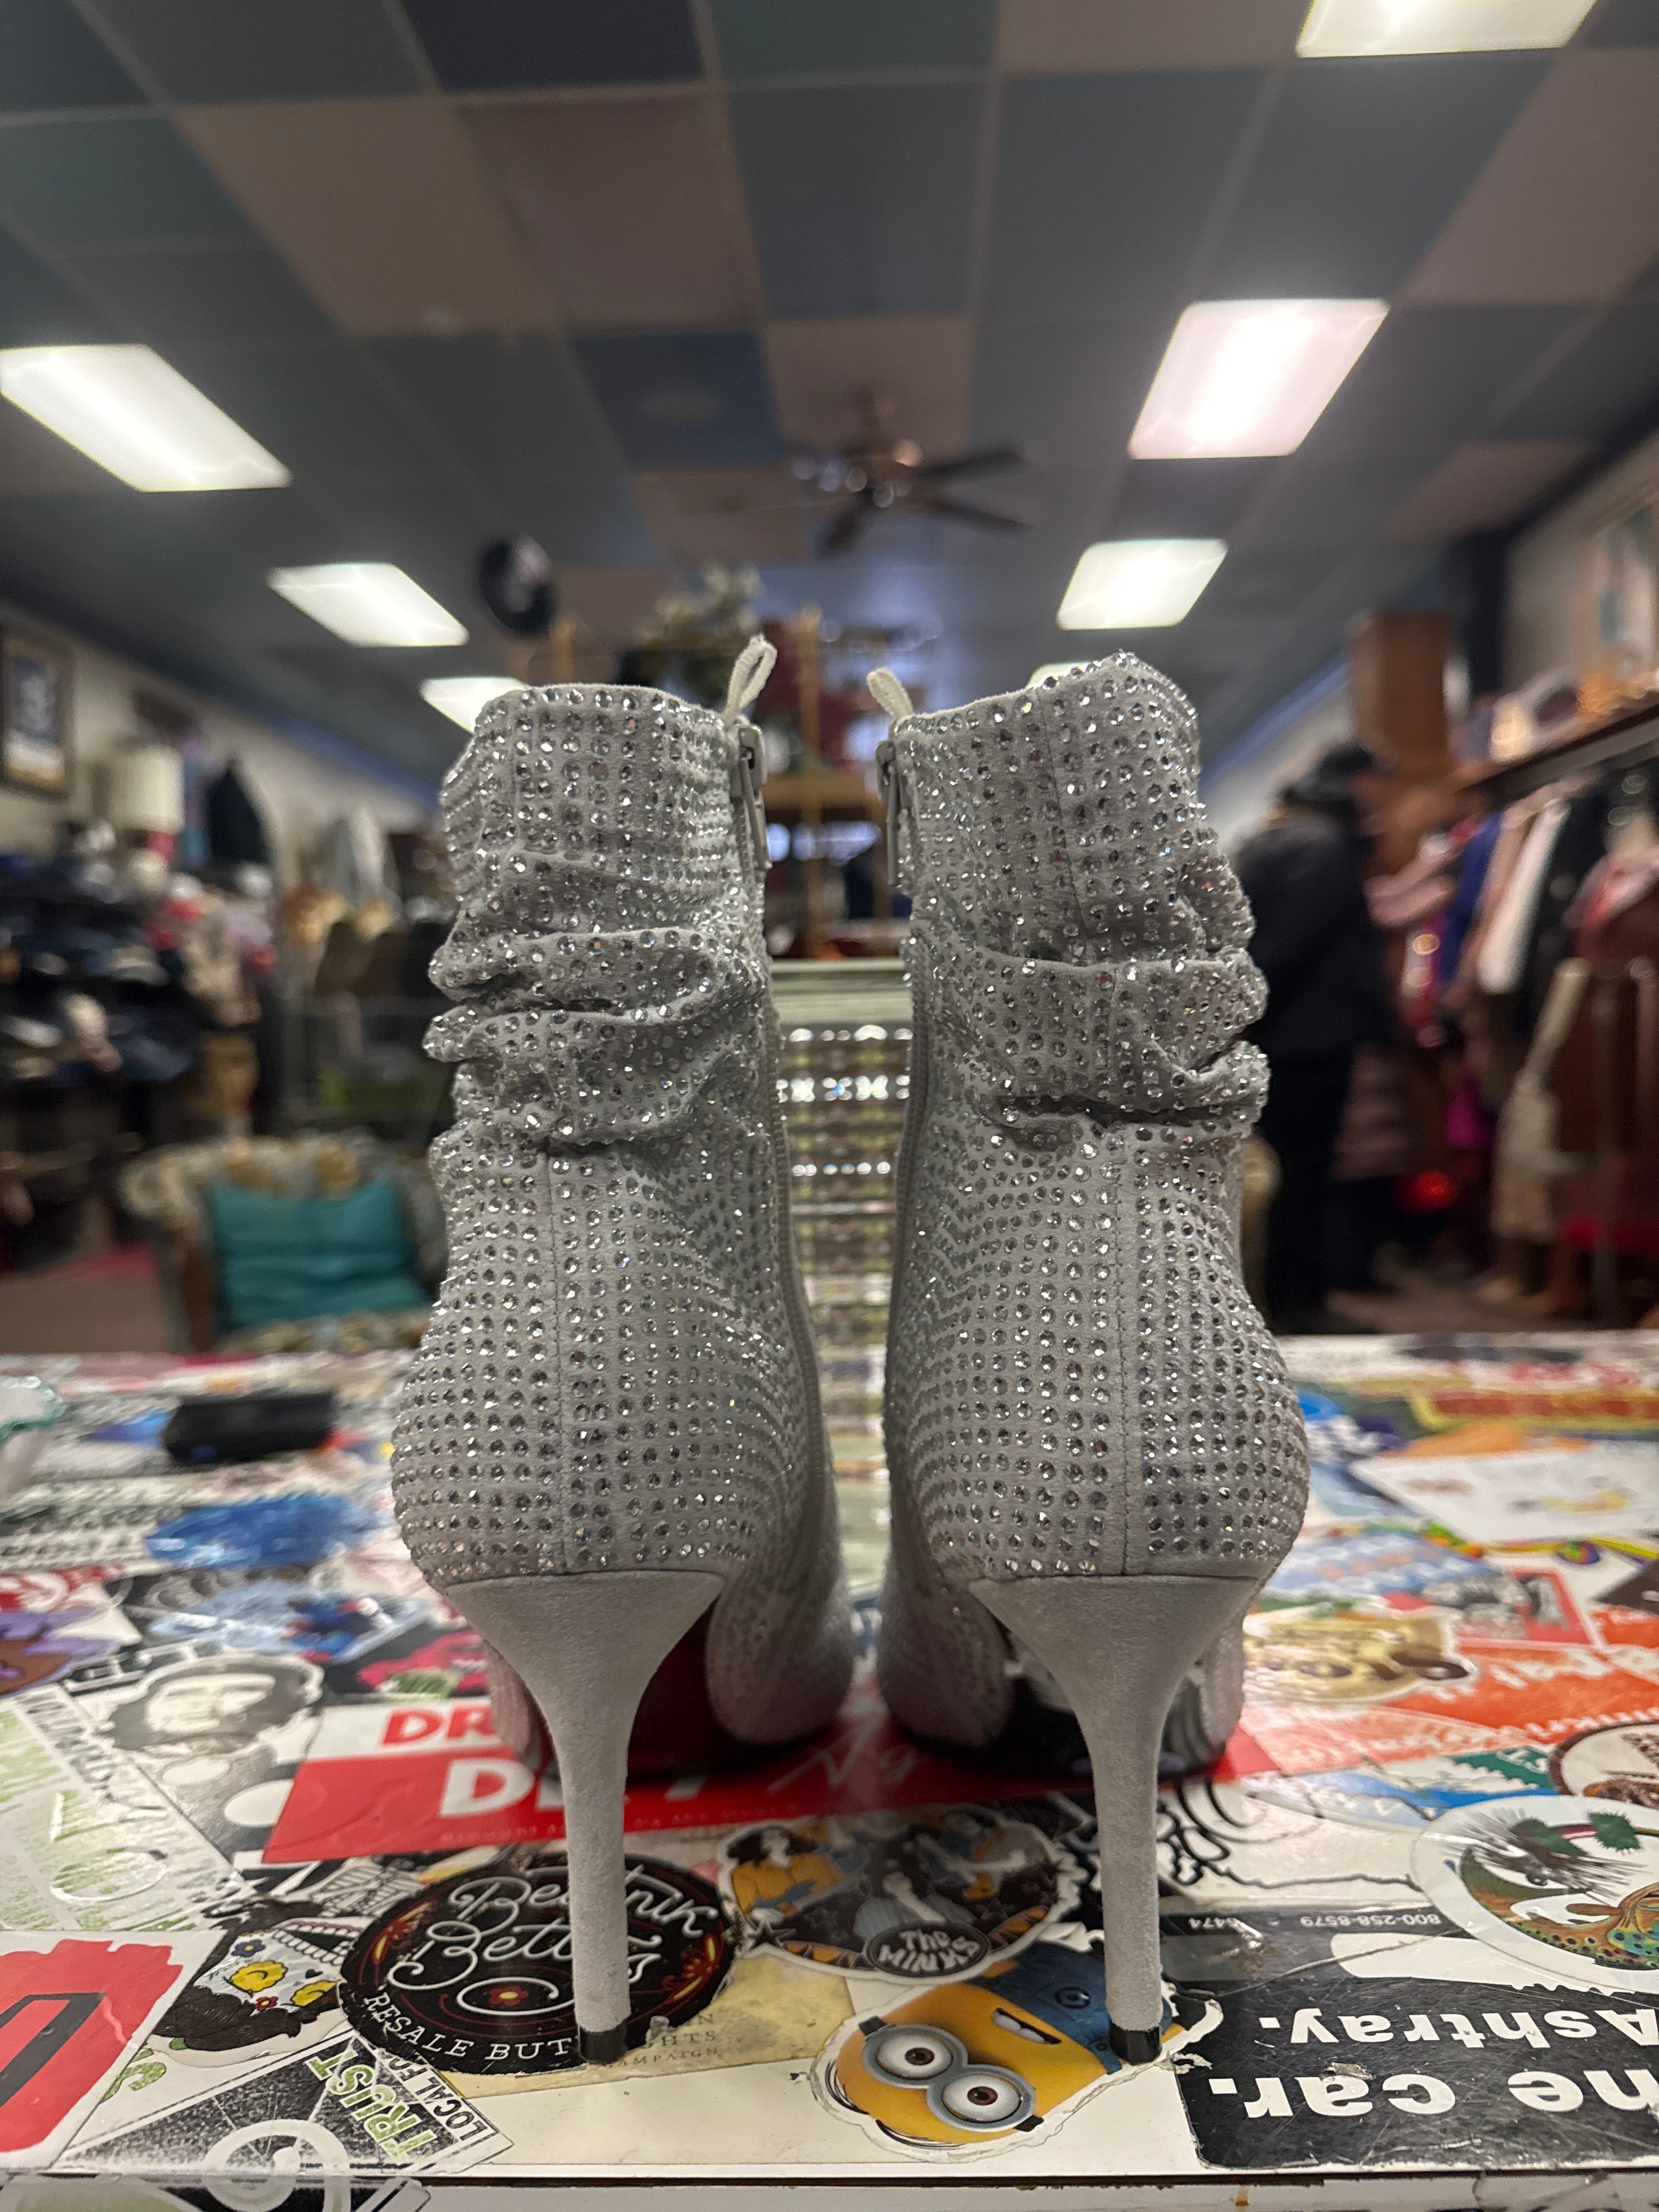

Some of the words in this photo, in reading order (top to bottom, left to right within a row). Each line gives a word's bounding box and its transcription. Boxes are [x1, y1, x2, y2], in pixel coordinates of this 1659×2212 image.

[448, 1864, 719, 1938] Benik
[1300, 1913, 1442, 1928] 800-258-8579
[386, 1916, 662, 1990] Betts
[900, 1928, 950, 1951] The
[364, 1991, 475, 2058] RESALE
[484, 2037, 578, 2061] BUT
[1259, 2008, 1659, 2048] Ashtray.
[618, 2047, 718, 2067] AMPAIGN
[304, 2049, 438, 2160] TRUST
[415, 2076, 488, 2141] LOCAL
[1209, 2073, 1457, 2118] car.
